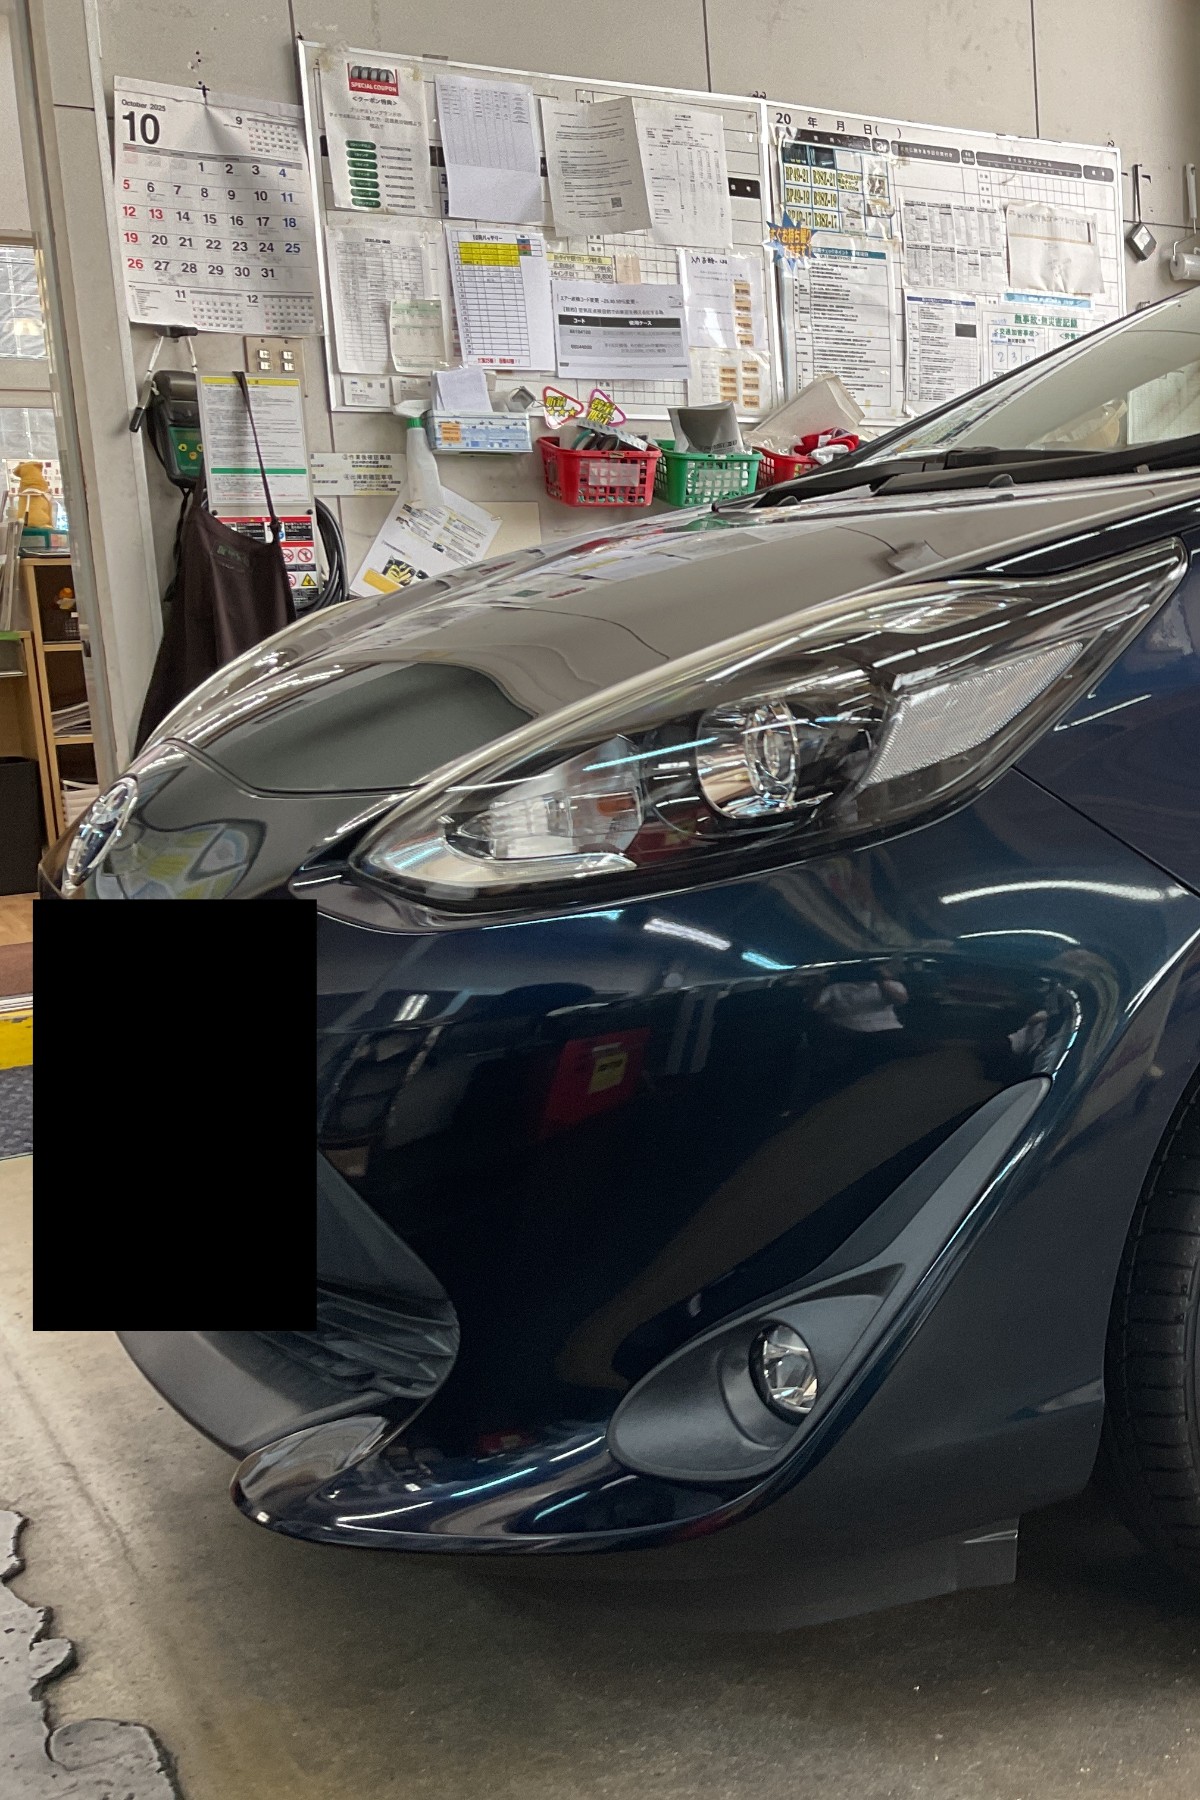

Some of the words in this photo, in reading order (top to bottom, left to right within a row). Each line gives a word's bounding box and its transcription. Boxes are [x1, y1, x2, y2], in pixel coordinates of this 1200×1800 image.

[350, 81, 372, 90] SPECIAL
[373, 83, 396, 92] COUPON
[121, 99, 147, 110] October
[150, 103, 166, 112] 2025
[123, 111, 160, 144] 10
[236, 116, 242, 125] 9
[776, 112, 791, 125] 20
[808, 117, 818, 128] 年
[836, 121, 845, 131] 月
[199, 162, 204, 172] 1
[225, 164, 233, 174] 2
[252, 165, 260, 175] 3
[279, 169, 286, 177] 4
[123, 179, 130, 189] 5
[147, 182, 154, 192] 6
[174, 185, 181, 194] 7
[201, 188, 208, 198] 8
[228, 190, 235, 200] 9
[254, 191, 268, 200] 10
[281, 193, 293, 202] 11
[123, 207, 136, 216] 12
[149, 209, 163, 219] 13
[176, 211, 190, 221] 14
[204, 214, 216, 224] 15
[230, 216, 243, 226] 16
[257, 217, 270, 226] 17
[283, 218, 296, 227] 18
[124, 233, 138, 242] 19
[152, 235, 167, 245] 20
[179, 237, 193, 247] 21
[206, 239, 221, 250] 22
[232, 242, 248, 252] 23
[259, 243, 274, 252] 24
[285, 244, 300, 253] 25
[128, 259, 143, 268] 26
[154, 261, 169, 271] 27
[181, 263, 196, 273] 28
[208, 265, 223, 275] 29
[235, 267, 250, 277] 30
[261, 268, 274, 278] 31
[176, 290, 186, 298] 11
[247, 295, 258, 303] 12
